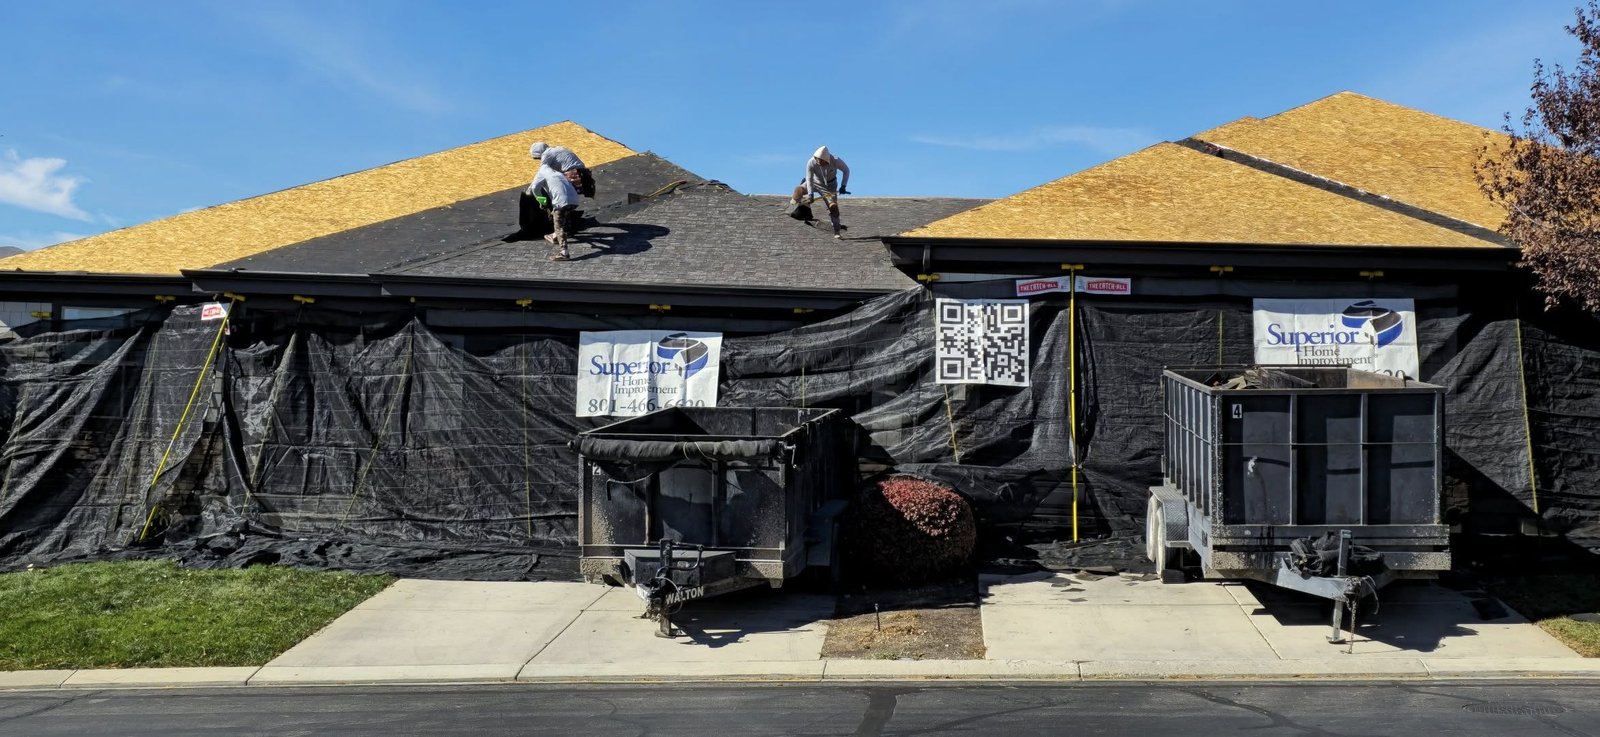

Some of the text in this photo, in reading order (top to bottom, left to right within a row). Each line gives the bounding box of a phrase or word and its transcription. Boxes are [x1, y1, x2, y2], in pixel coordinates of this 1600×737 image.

[1266, 323, 1359, 352] Superior
[1304, 345, 1340, 356] Home
[1297, 355, 1373, 365] Improvement
[590, 354, 671, 382] Superior
[622, 376, 652, 386] Home
[614, 385, 678, 397] Improvement
[1233, 404, 1241, 418] 4
[665, 585, 705, 605] WALTON
